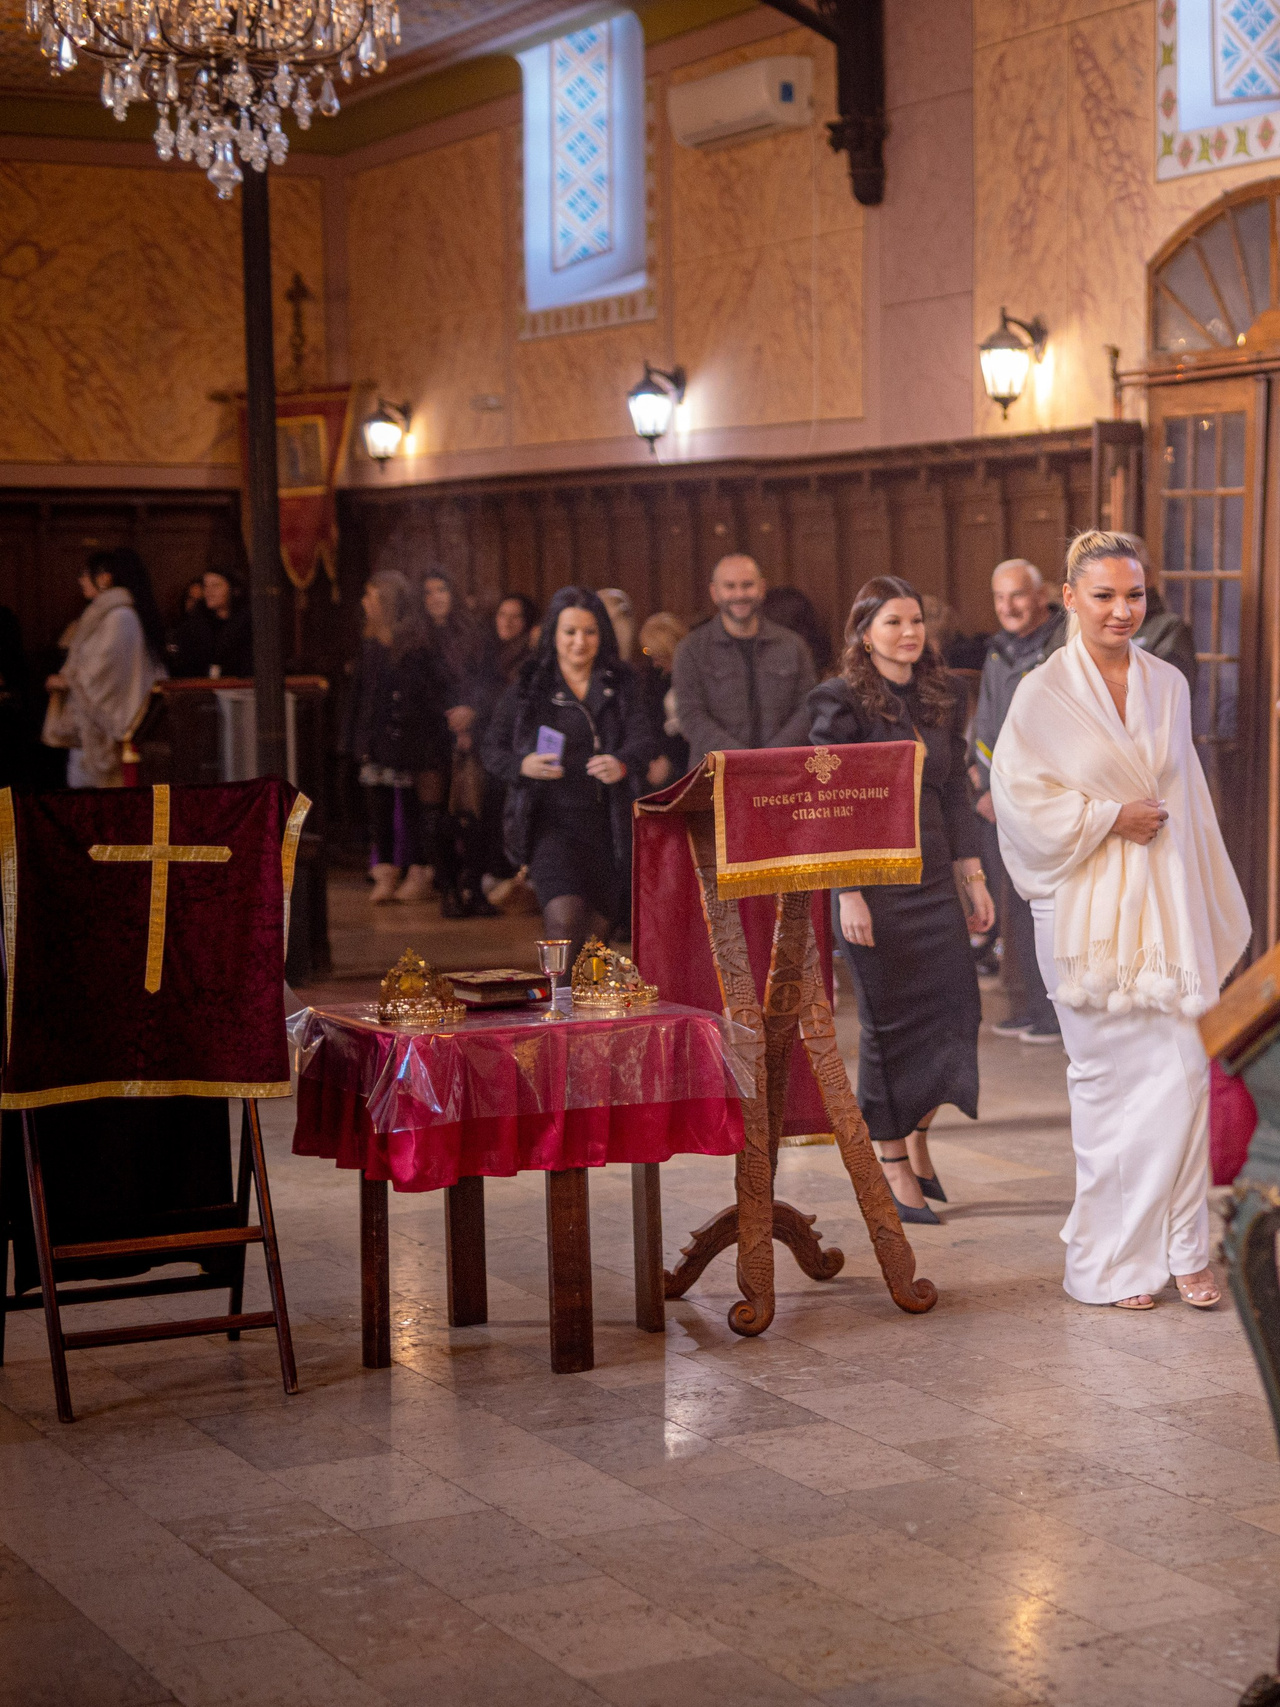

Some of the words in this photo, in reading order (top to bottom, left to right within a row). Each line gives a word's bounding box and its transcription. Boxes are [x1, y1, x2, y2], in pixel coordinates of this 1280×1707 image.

[752, 791, 812, 808] ПРЕСВЕТА
[818, 787, 889, 801] БОГОРОДИЦЕ
[792, 806, 830, 820] СПАСИ
[833, 805, 854, 818] НАС!
